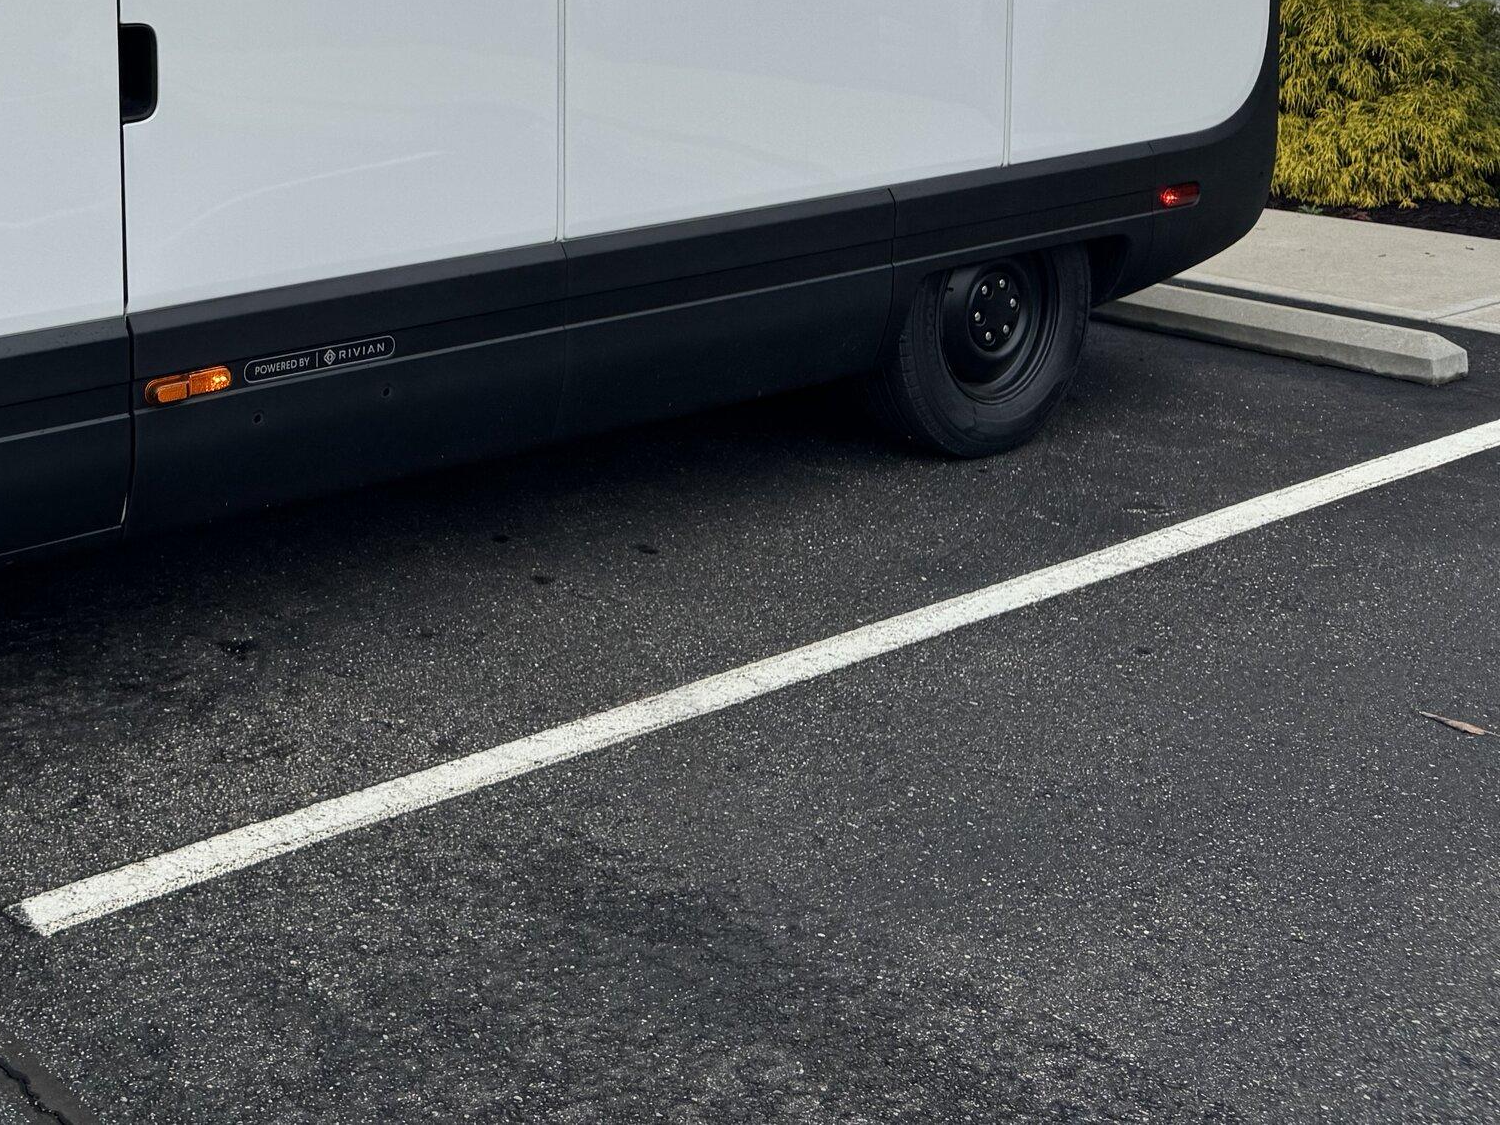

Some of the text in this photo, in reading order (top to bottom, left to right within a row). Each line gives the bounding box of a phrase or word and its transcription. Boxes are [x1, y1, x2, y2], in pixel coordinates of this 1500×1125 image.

[255, 343, 385, 375] POWERED BY RIVIAN
